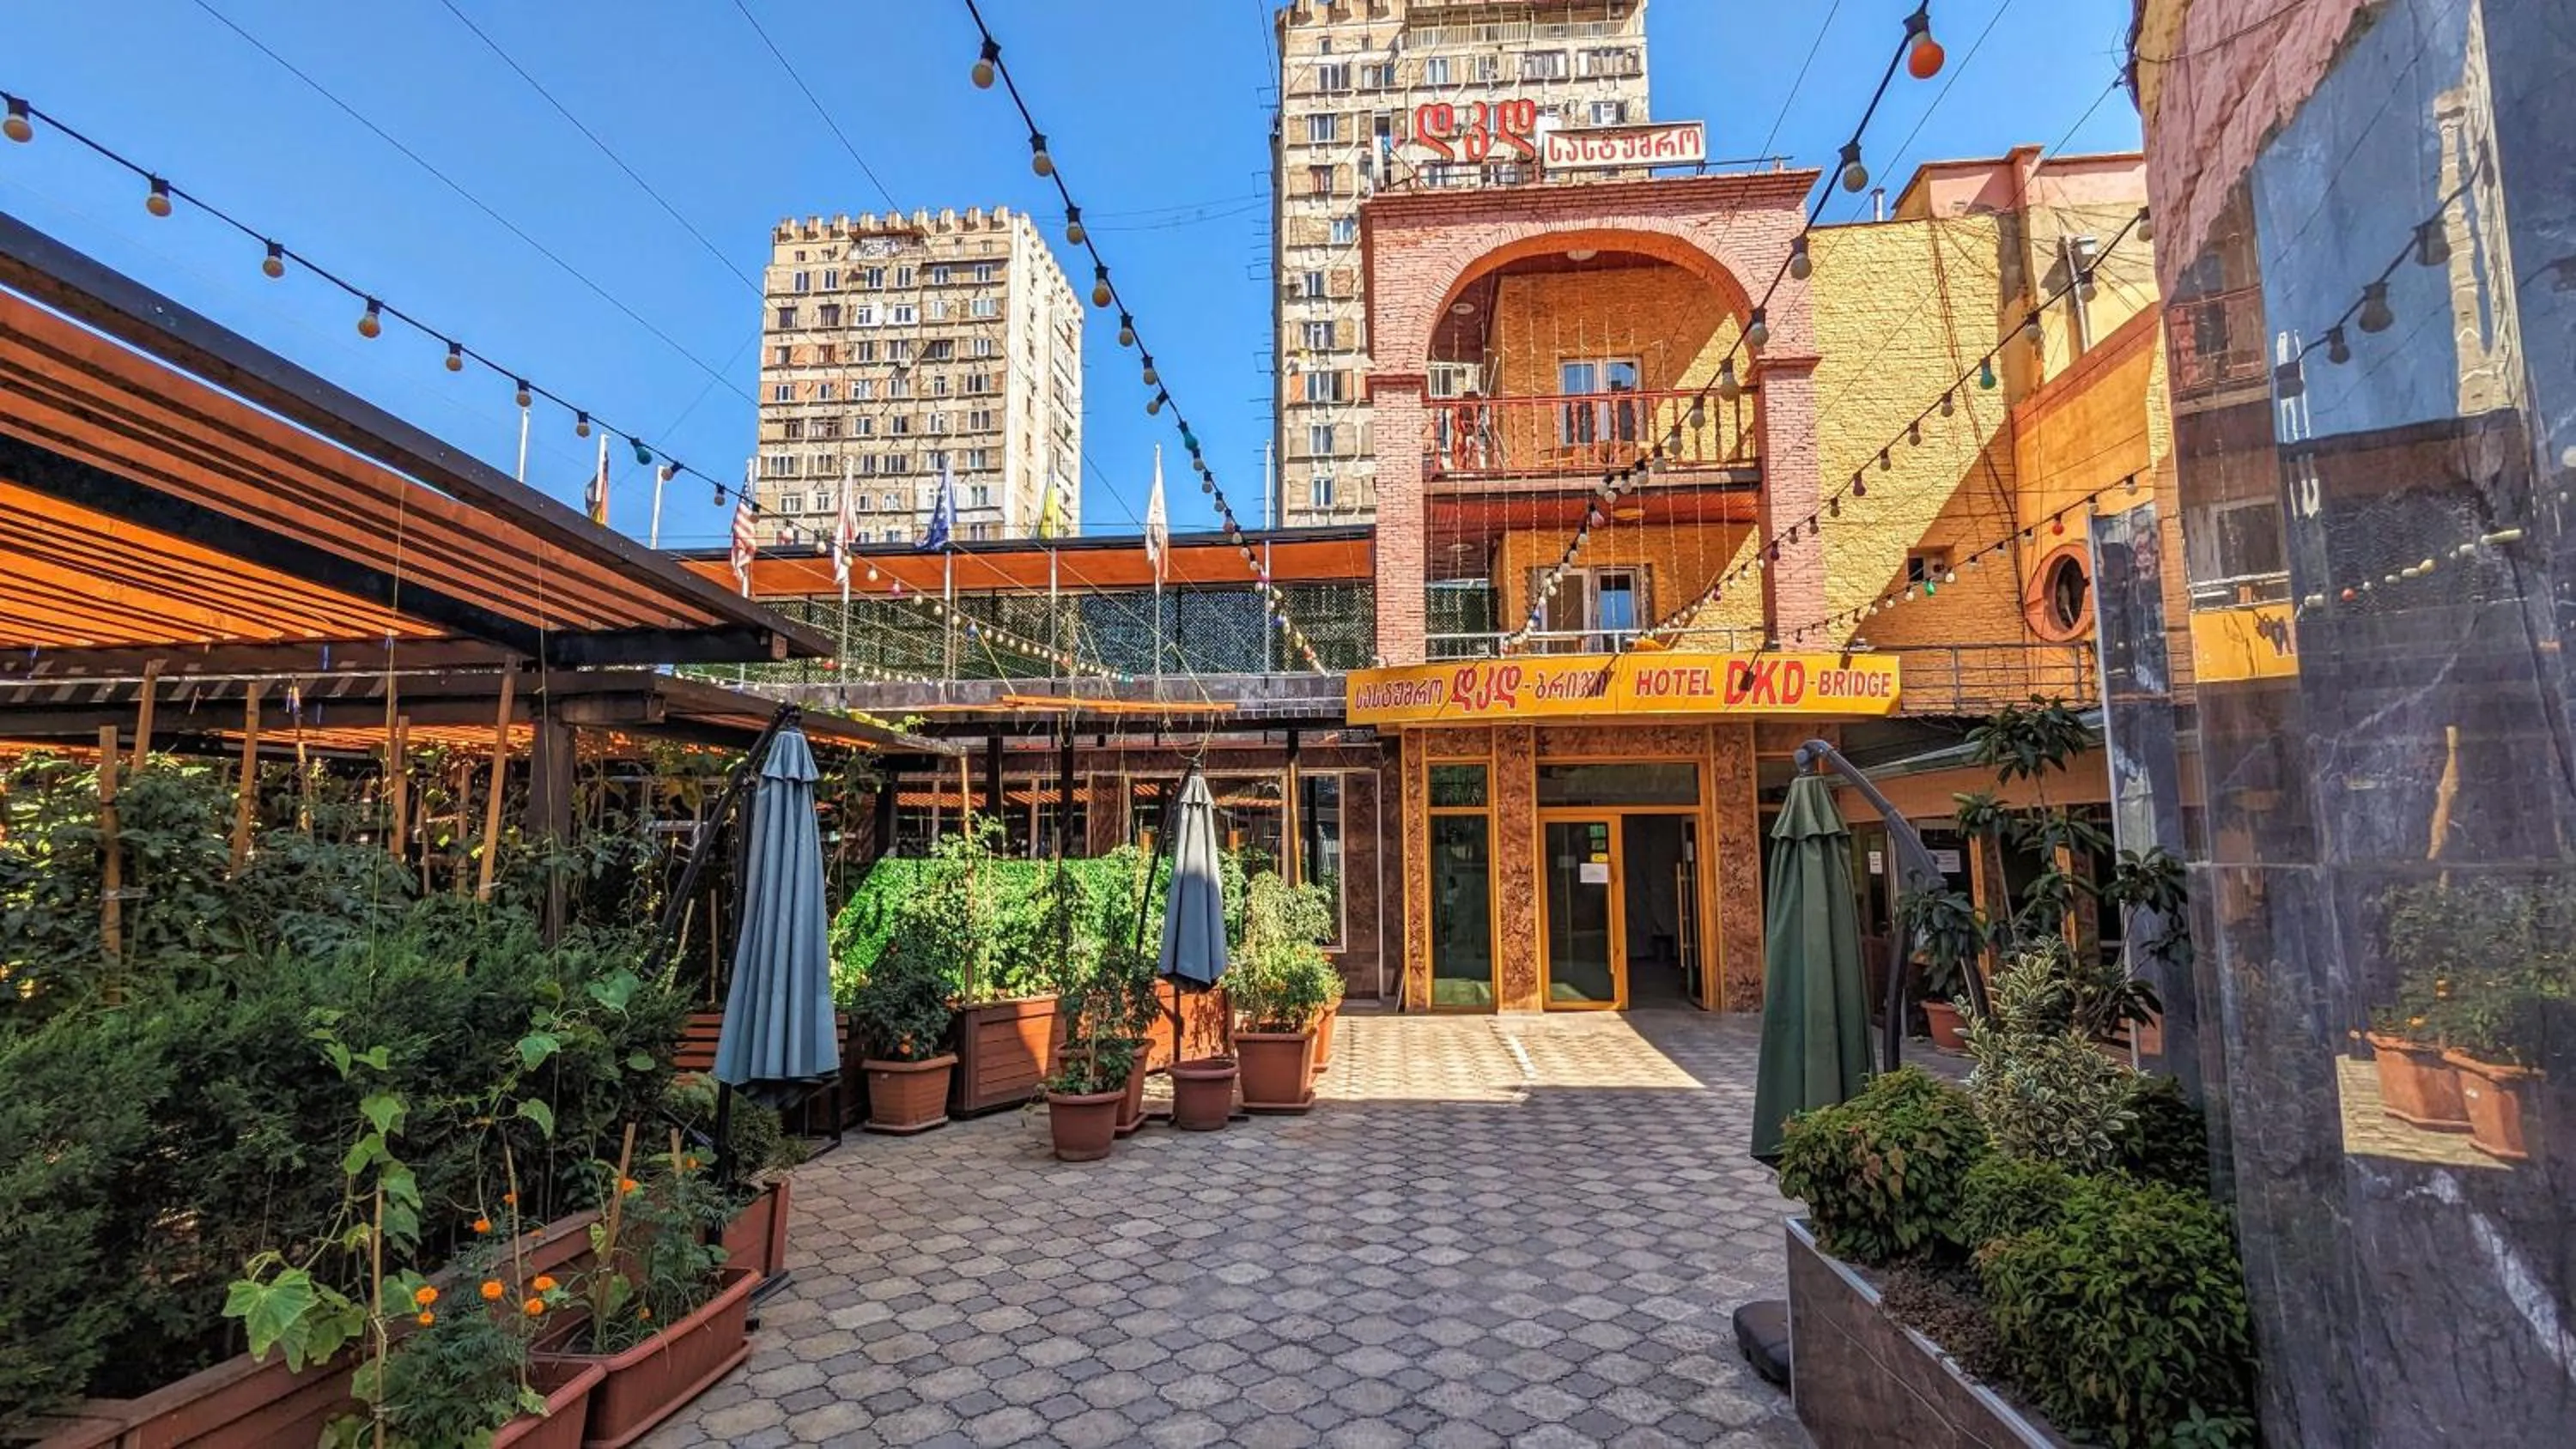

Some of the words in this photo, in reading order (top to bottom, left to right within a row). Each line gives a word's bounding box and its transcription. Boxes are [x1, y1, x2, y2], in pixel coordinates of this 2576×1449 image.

[1548, 130, 1699, 161] სასტუმრო
[1356, 679, 1443, 709] სასტუმრო
[1635, 669, 1714, 696] HOTEL
